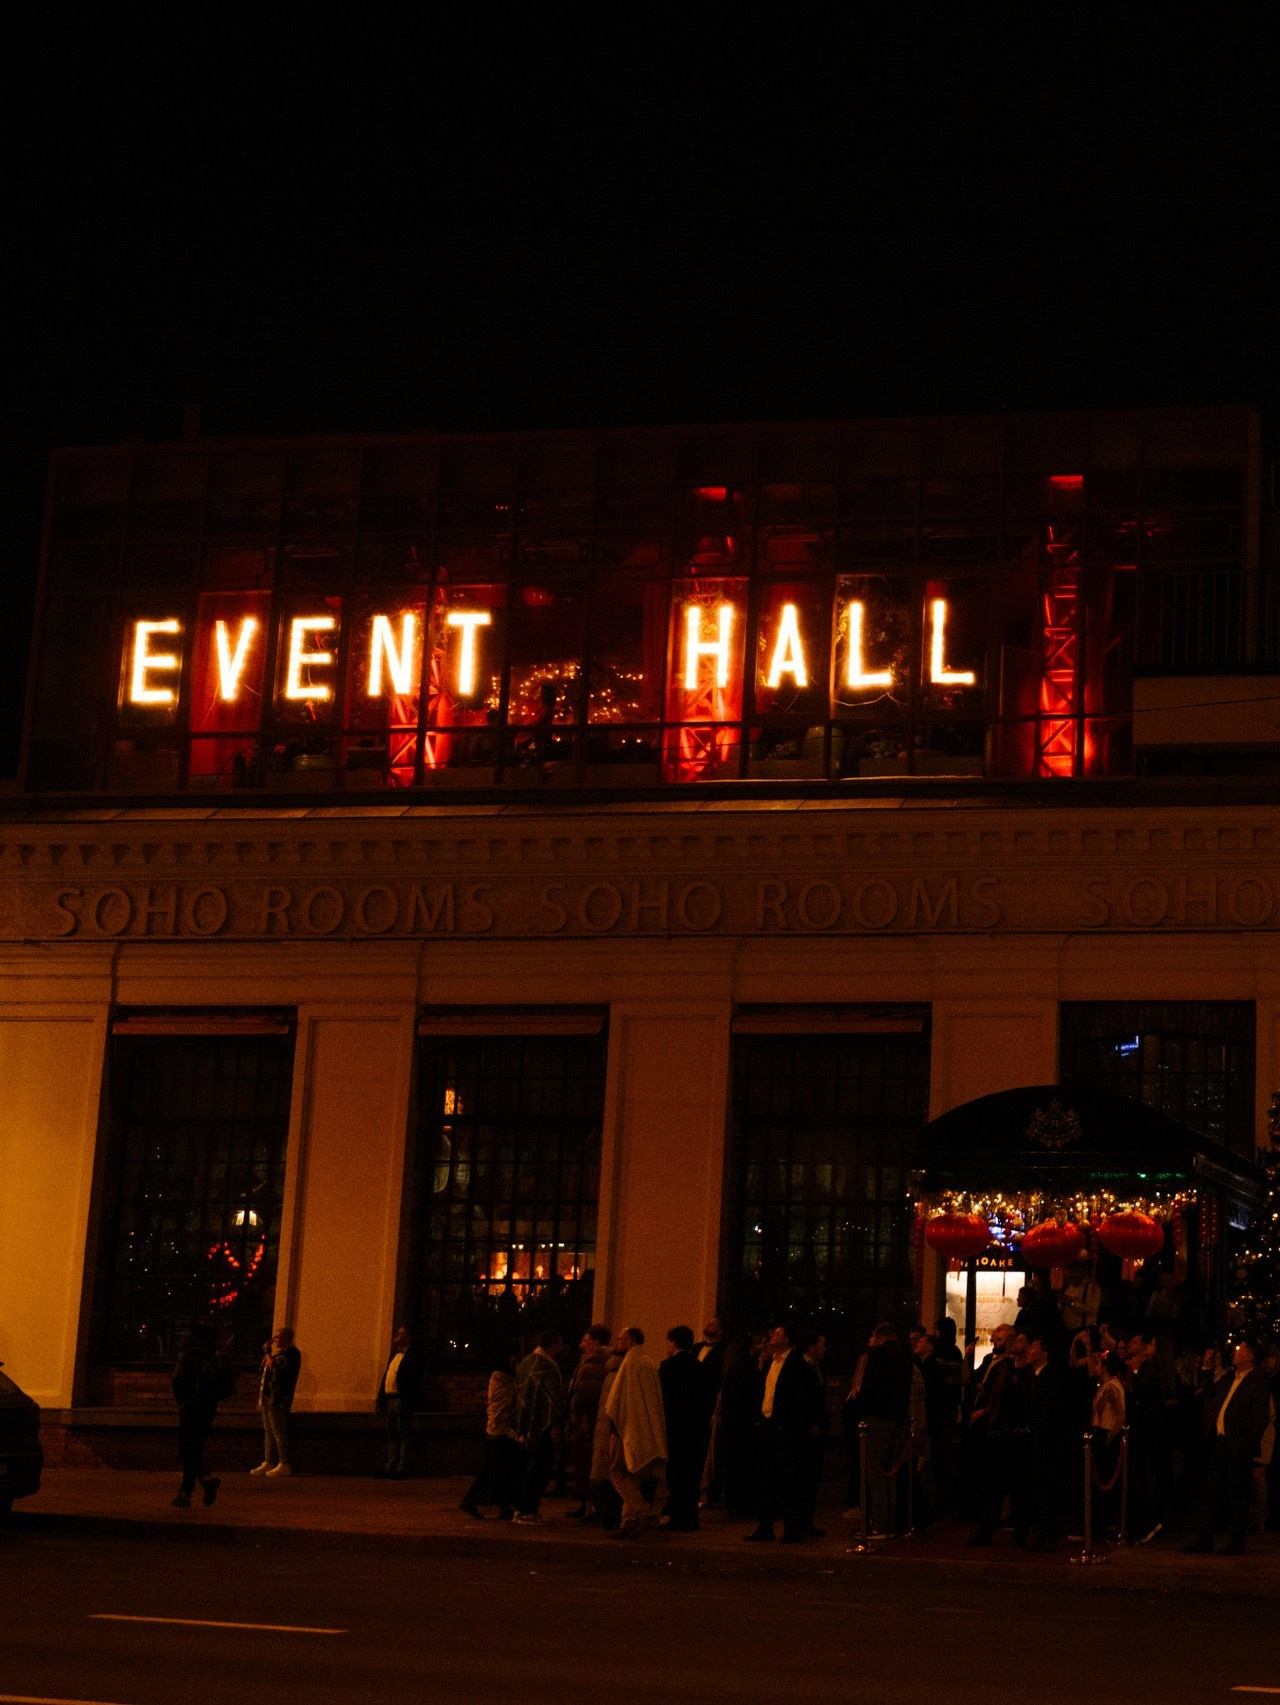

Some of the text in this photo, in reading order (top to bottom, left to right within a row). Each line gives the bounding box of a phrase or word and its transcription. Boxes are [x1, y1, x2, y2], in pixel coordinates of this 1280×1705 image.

[128, 599, 976, 706] EVENT HALL
[54, 884, 230, 937] SOHO
[262, 881, 495, 935] ROOMS
[539, 879, 722, 933] SOHO
[755, 876, 1001, 931] ROOMS
[1078, 873, 1276, 927] SOHO
